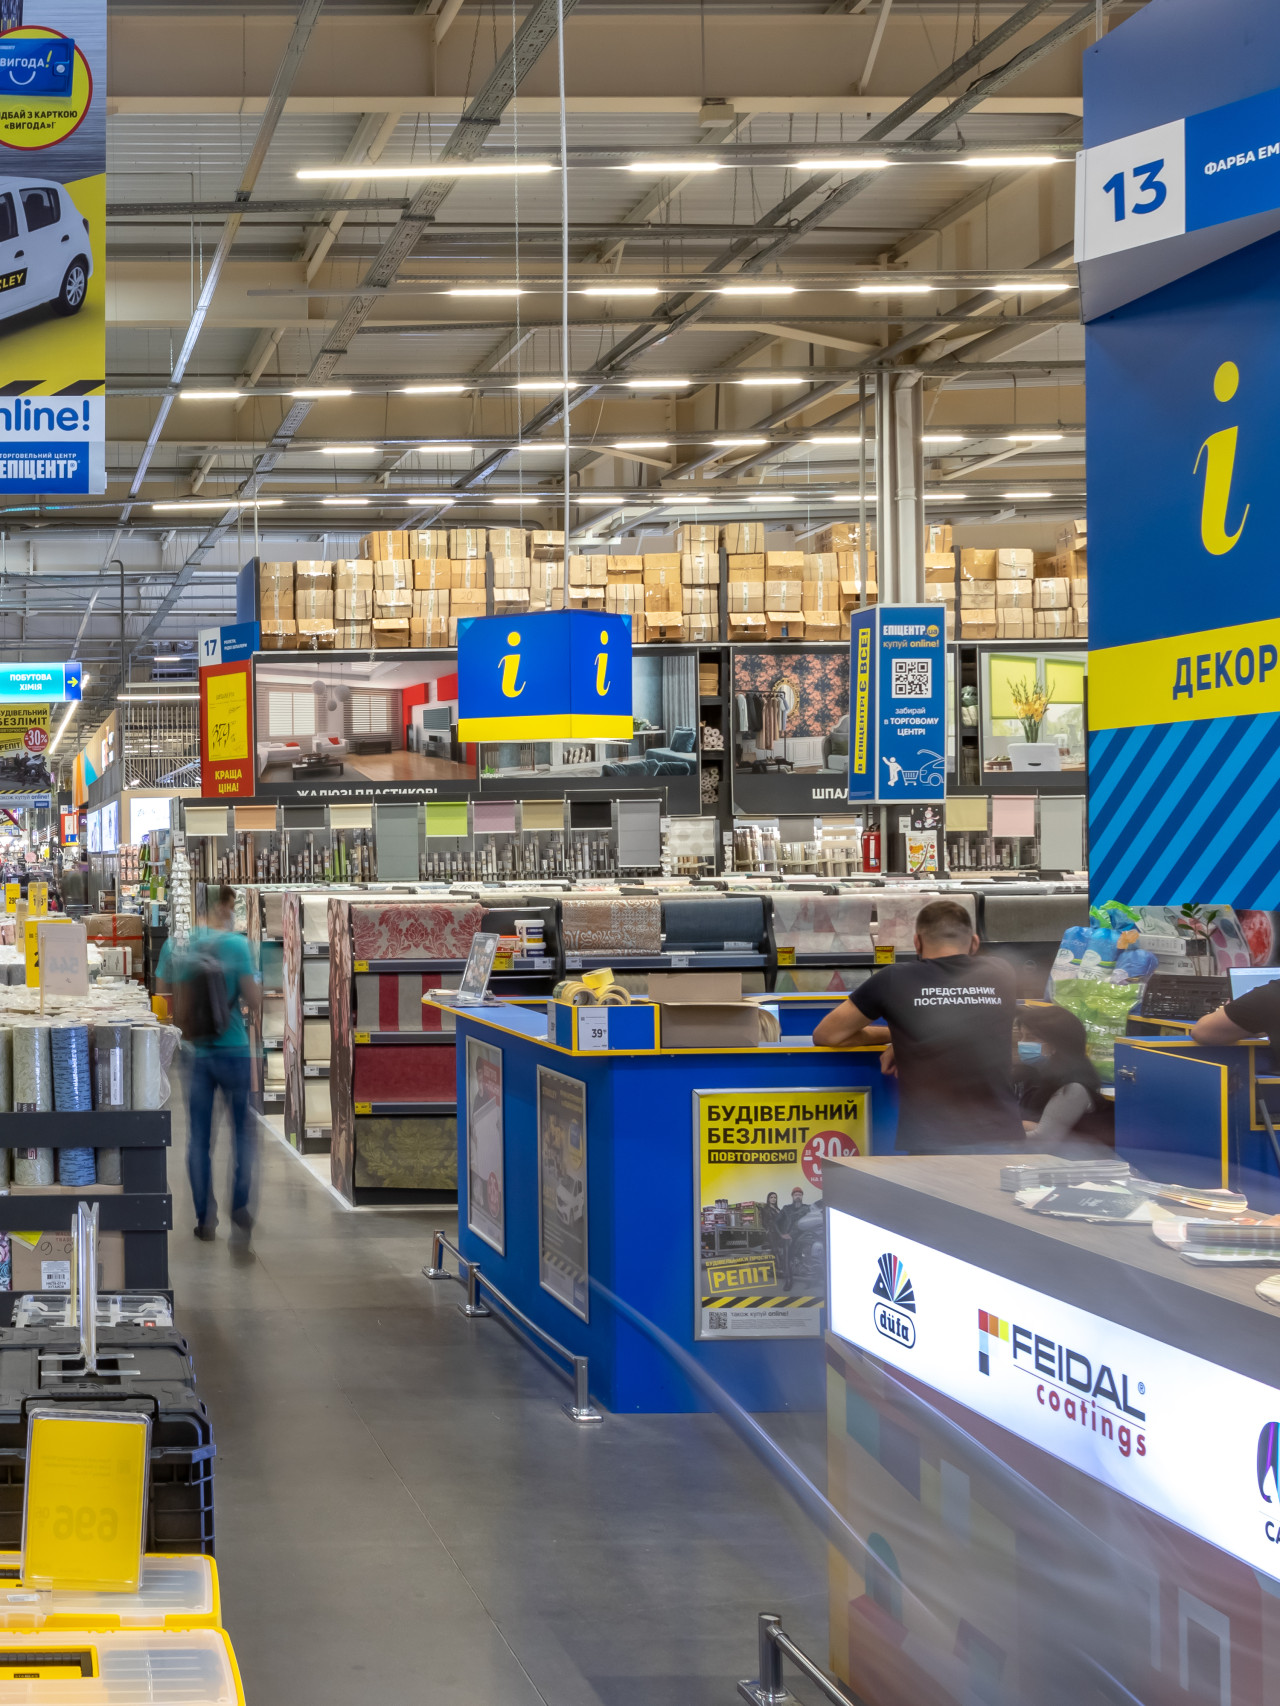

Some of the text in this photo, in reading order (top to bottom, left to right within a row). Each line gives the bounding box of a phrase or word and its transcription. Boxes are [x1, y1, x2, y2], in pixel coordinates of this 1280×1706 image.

[34, 111, 78, 119] КАРТКОЮ
[1204, 150, 1256, 176] ФАРБА
[1102, 158, 1168, 223] 13
[204, 638, 218, 656] 17
[883, 640, 940, 650] купуй online!
[9, 673, 52, 681] ПОБУТОВА
[1172, 643, 1278, 701] ДЕКОР
[19, 683, 43, 691] ХІМІЯ
[895, 707, 926, 716] забирай
[890, 717, 939, 725] ТОРГОВОМУ
[897, 728, 926, 736] ЦЕНТРІ
[0, 742, 21, 751] РЕПІТ
[214, 769, 242, 781] КРАЩА
[218, 783, 239, 794] ЦІНА!
[921, 986, 996, 997] ПРЕДСТАВНИК
[914, 996, 1003, 1007] ПОСТАЧАЛЬНИКА
[591, 1028, 603, 1039] 39
[707, 1100, 859, 1125] БУДІВЕЛЬНИЙ
[707, 1127, 810, 1144] БЕЗЛІМІТ
[710, 1151, 796, 1163] ПОВТОРЮЄМО
[713, 1266, 771, 1288] РЕПІТ
[879, 1308, 910, 1343] düfa
[1012, 1323, 1146, 1422] FEIDAL
[1036, 1383, 1147, 1458] coatings
